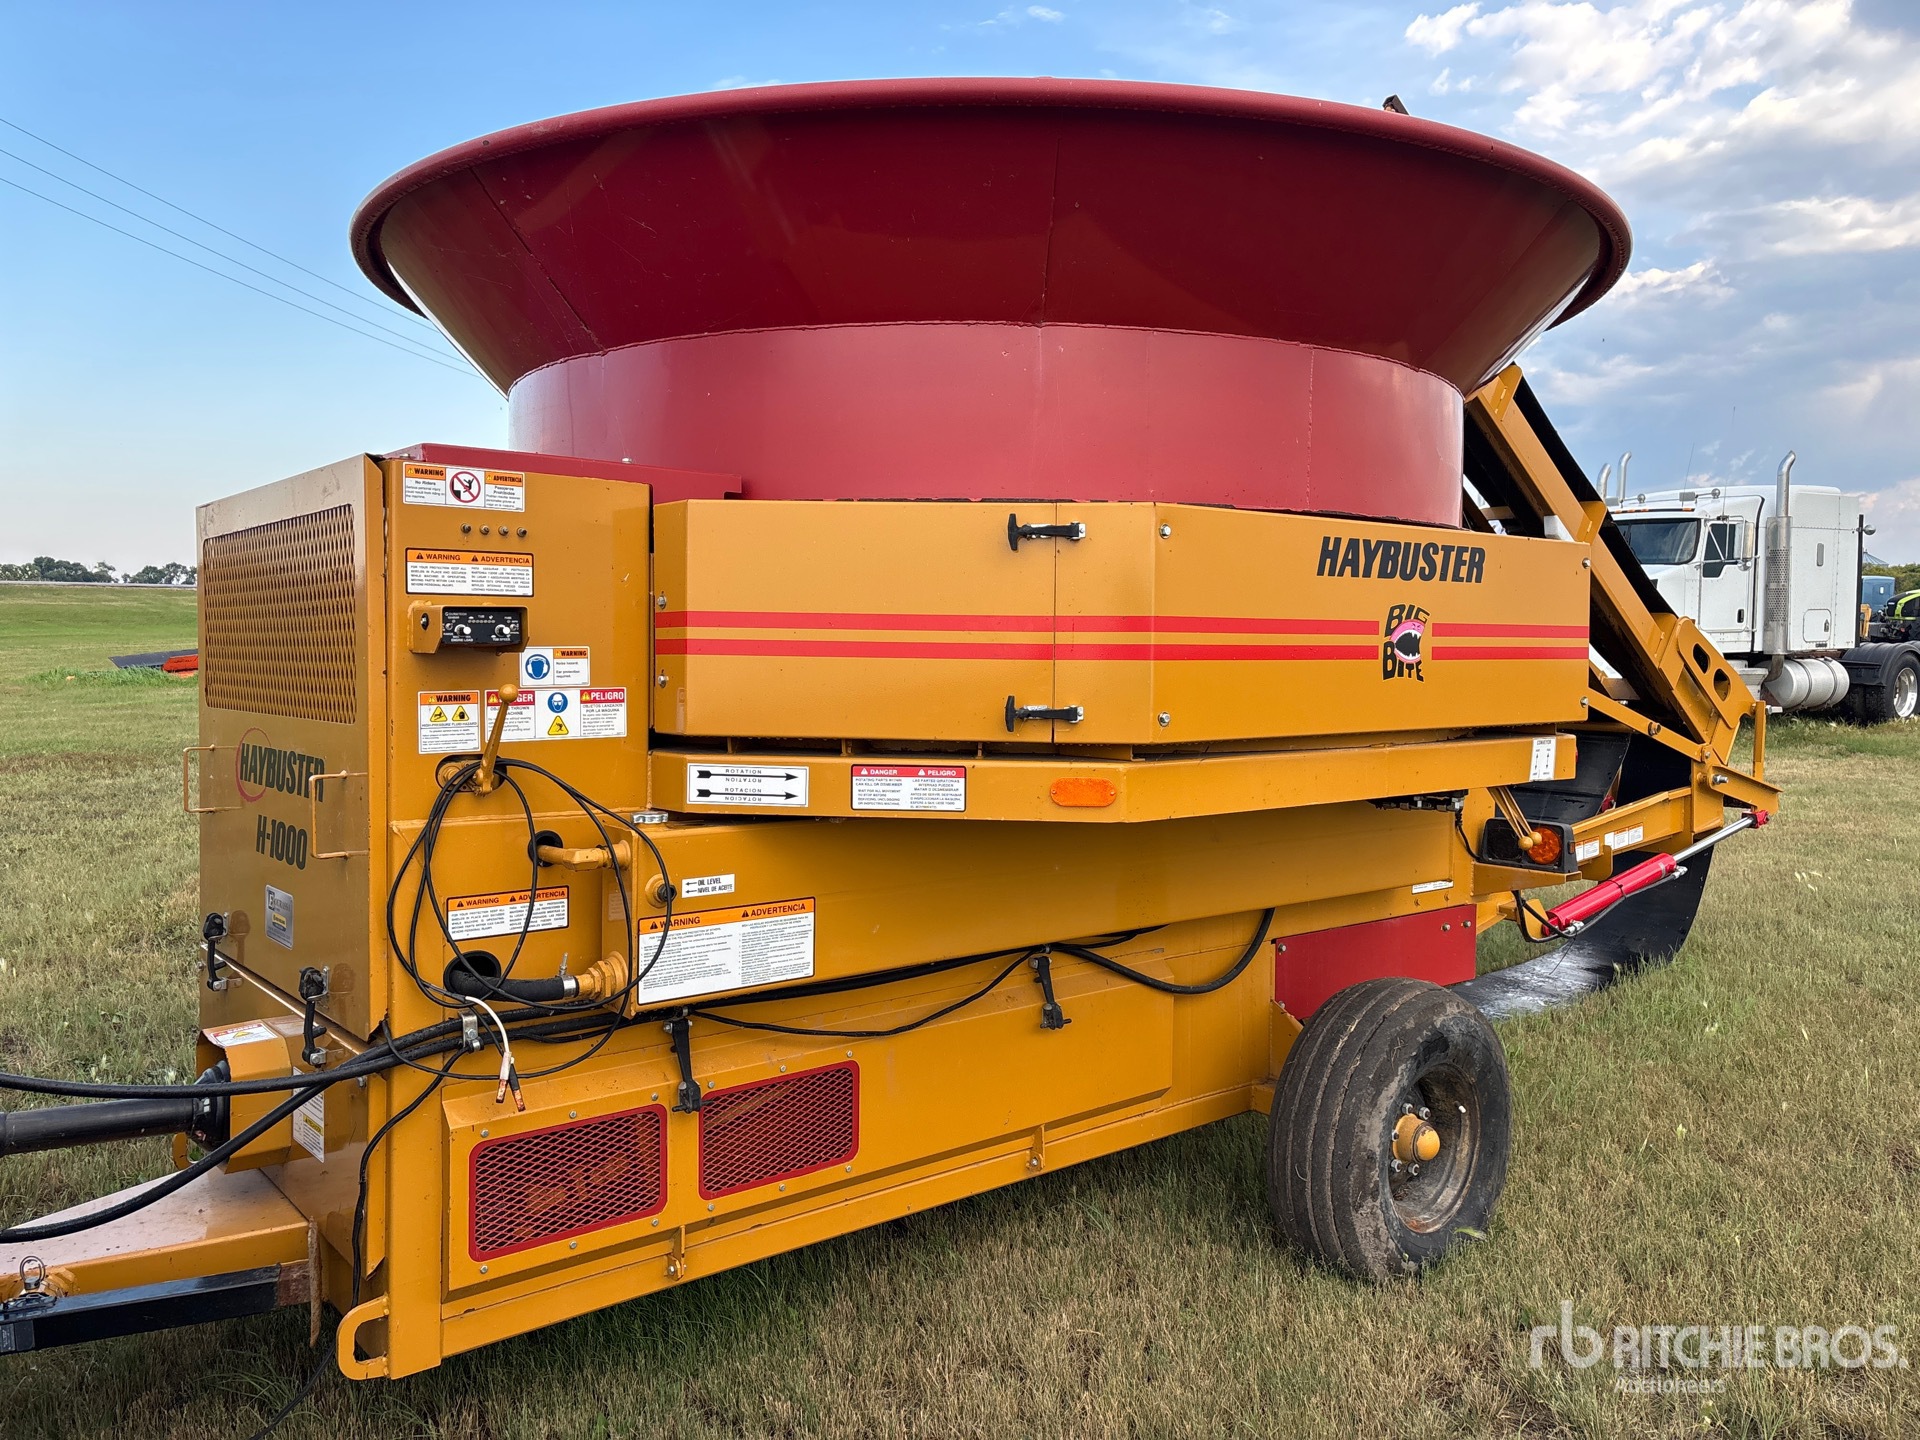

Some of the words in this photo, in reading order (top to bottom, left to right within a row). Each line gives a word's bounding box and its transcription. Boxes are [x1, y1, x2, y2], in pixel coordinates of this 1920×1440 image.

[414, 468, 444, 476] WARNING
[1316, 536, 1486, 583] HAYBUSTER
[1384, 604, 1430, 638] BIG
[1383, 640, 1424, 682] BITE
[591, 692, 624, 700] PELIGRO
[240, 743, 325, 802] HAYBUSTER
[256, 814, 308, 870] H-1000
[466, 897, 499, 906] WARNING
[518, 891, 565, 901] ADVRTENCIA
[751, 903, 805, 916] ADVERTENCIA
